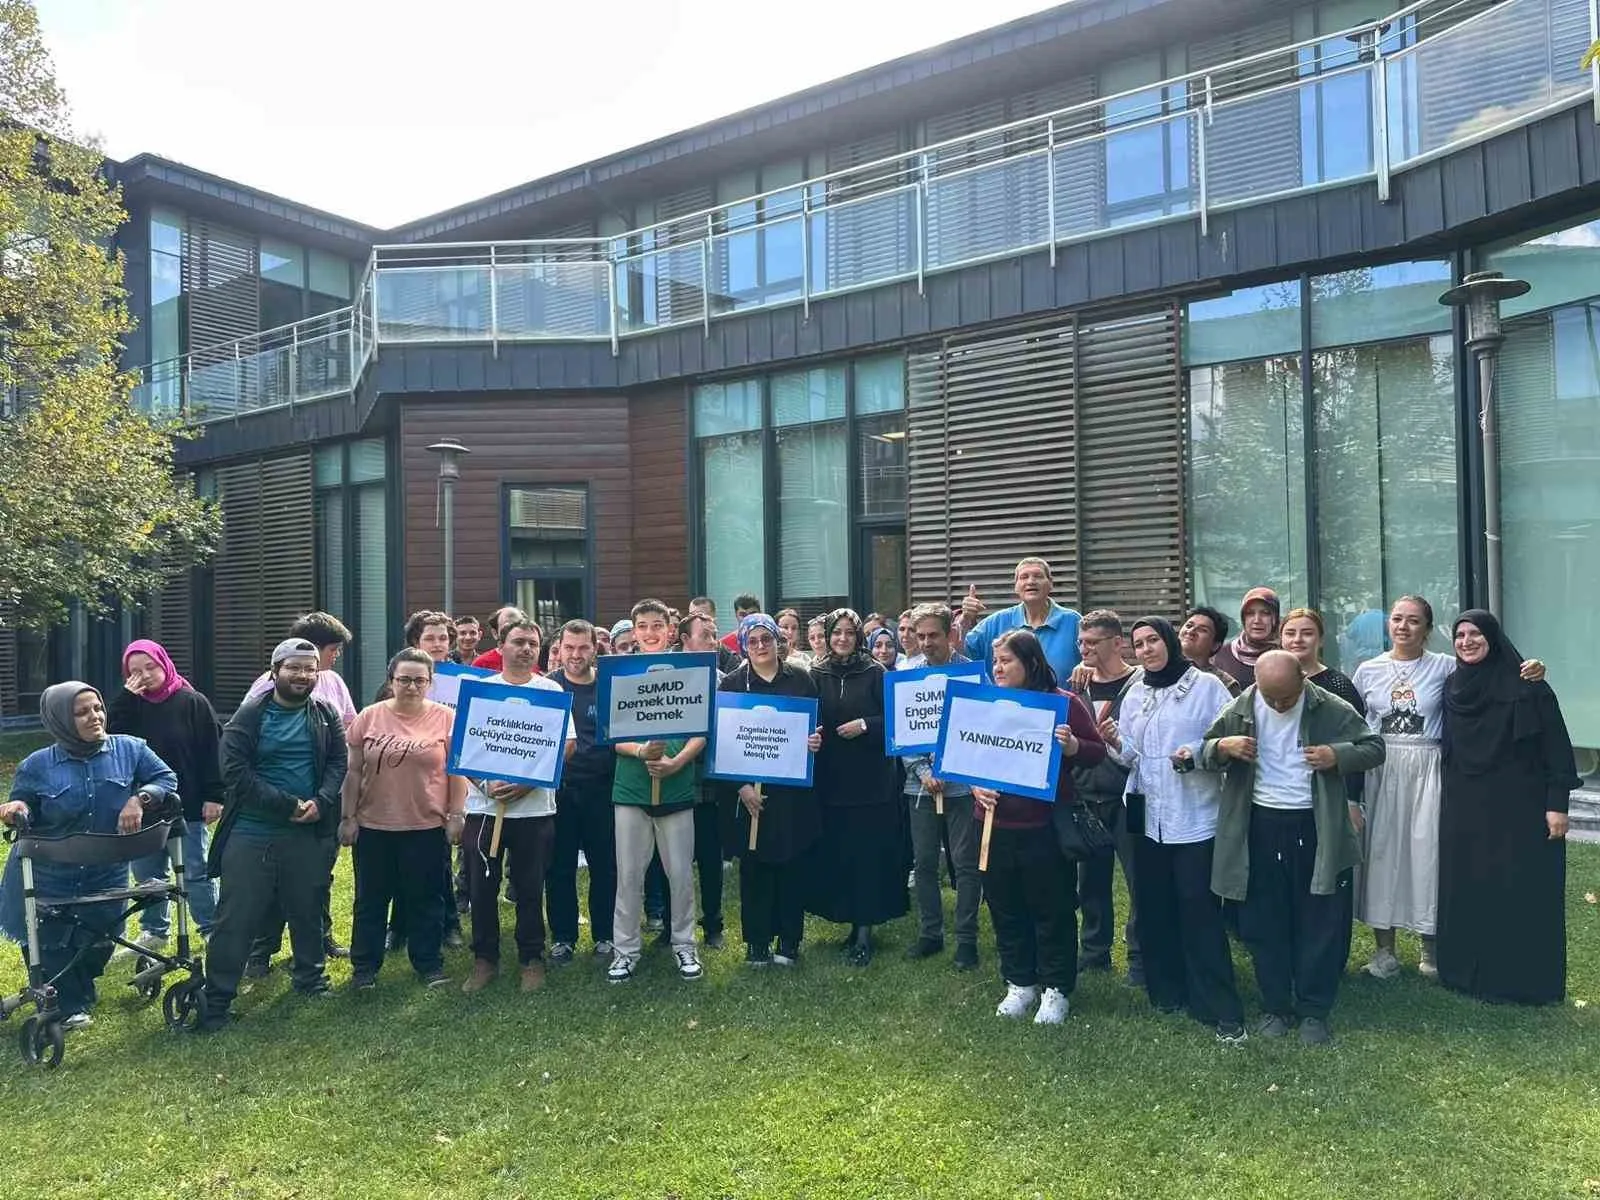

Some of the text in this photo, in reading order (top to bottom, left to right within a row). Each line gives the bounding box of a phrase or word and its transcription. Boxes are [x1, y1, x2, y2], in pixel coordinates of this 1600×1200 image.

[637, 681, 684, 694] SUMUD
[618, 694, 703, 710] Demek Umut
[636, 709, 683, 721] Demek
[469, 727, 556, 748] Güçlüyüz Gazzenin
[959, 730, 1044, 754] YANINIZDAYIZ
[485, 742, 537, 759] Yanındayız
